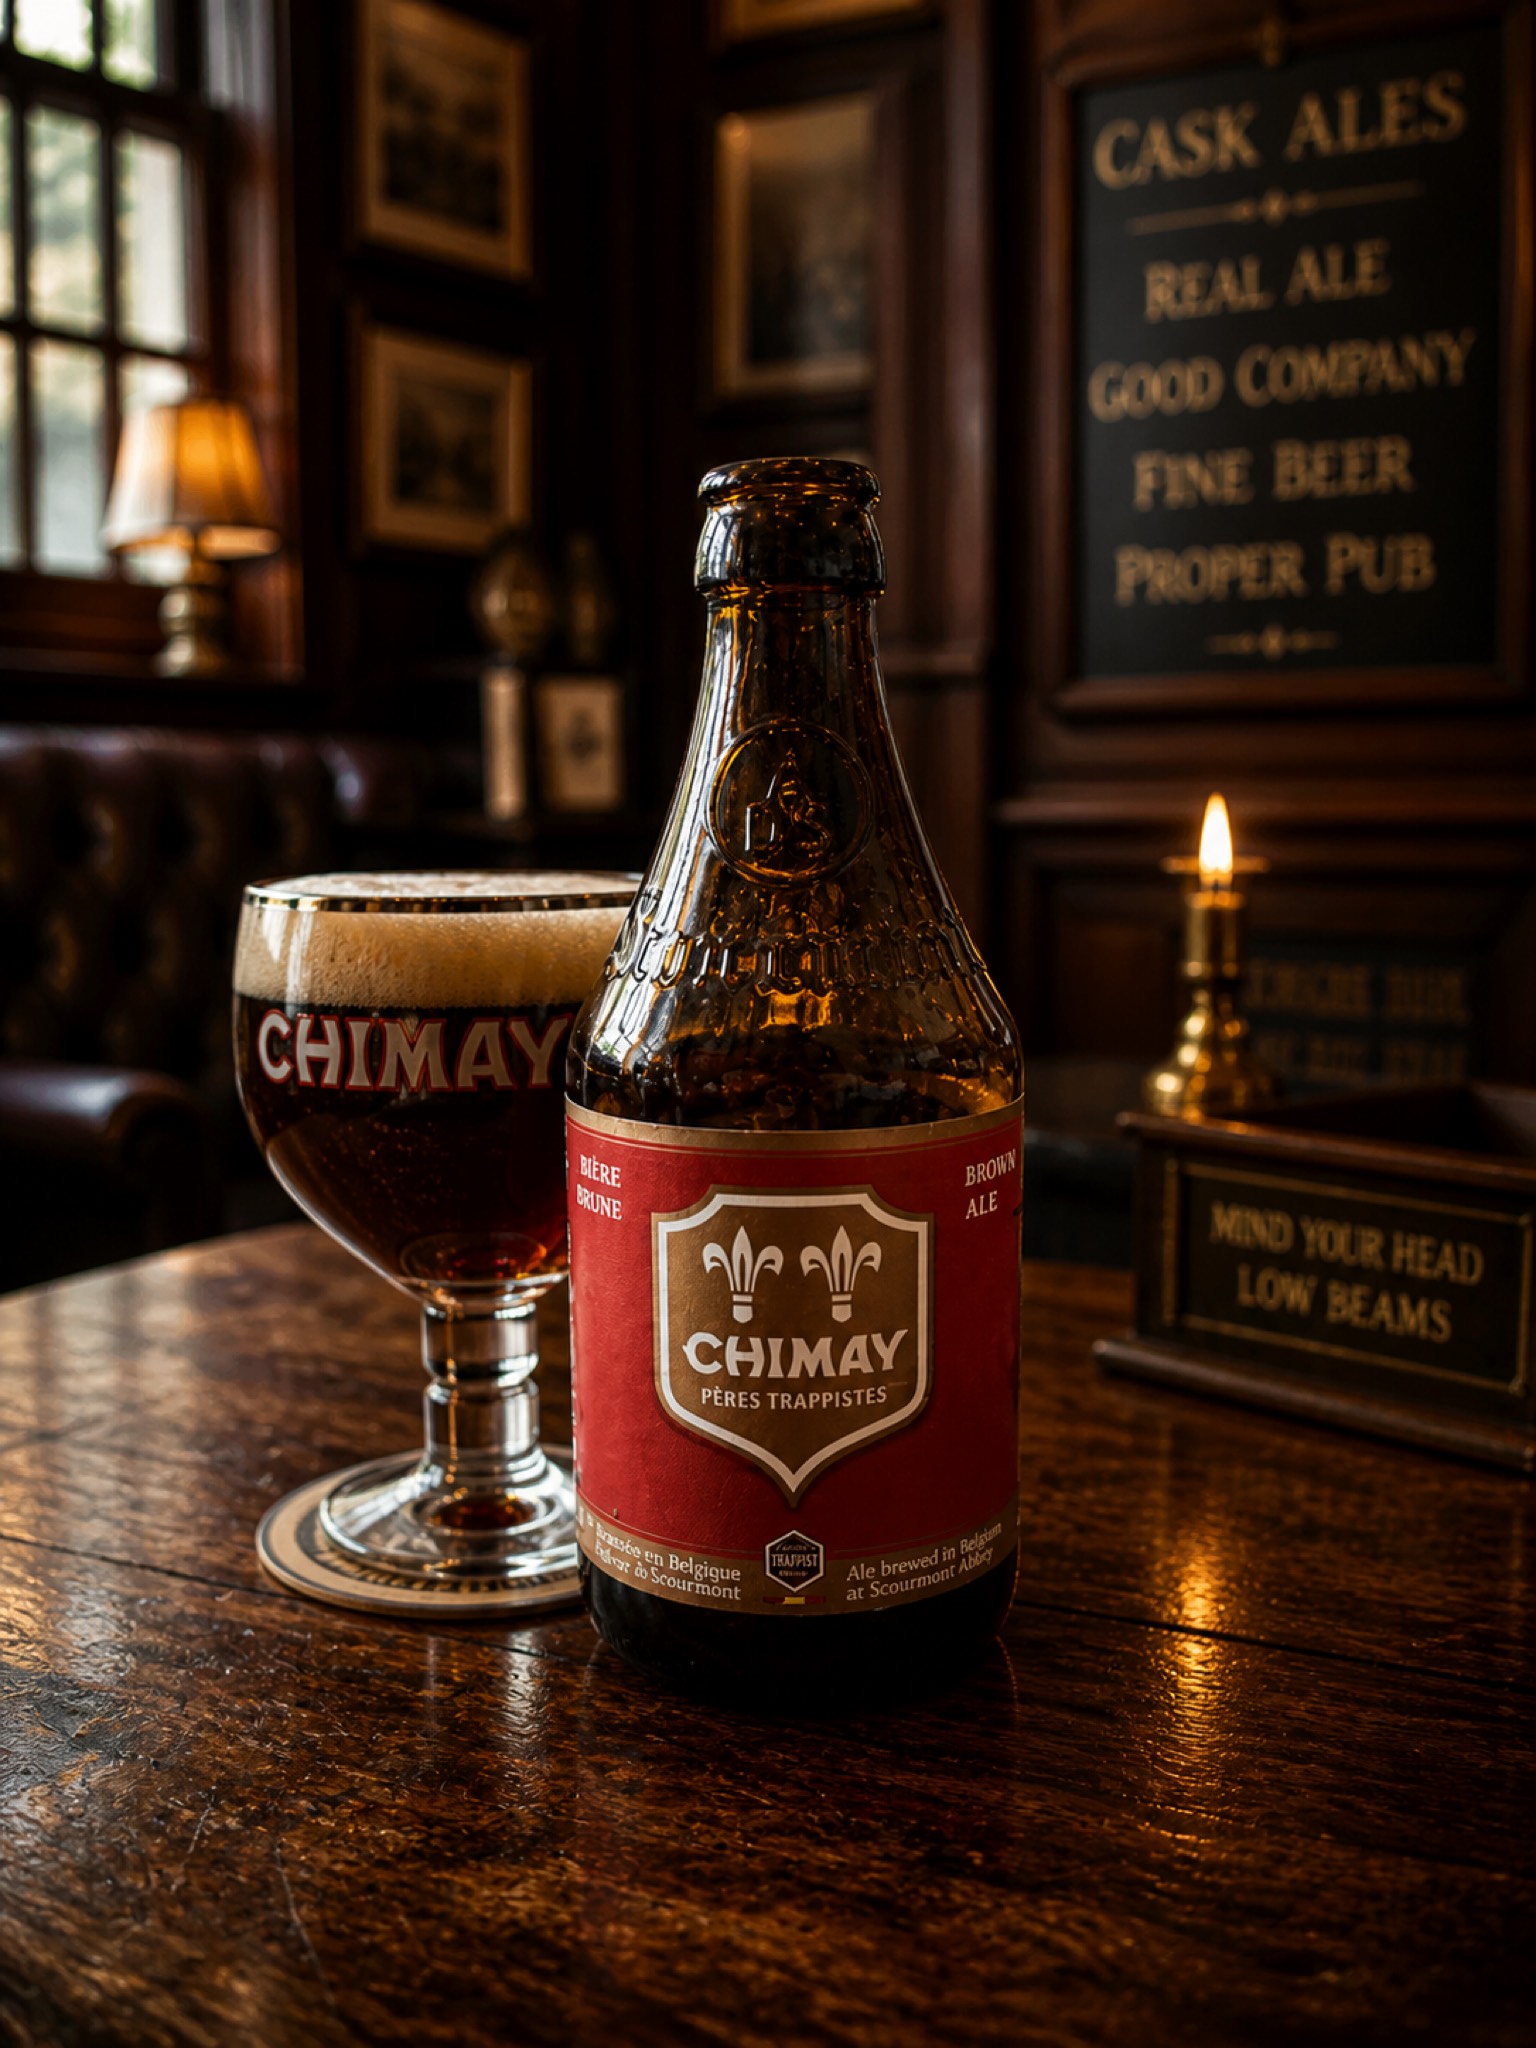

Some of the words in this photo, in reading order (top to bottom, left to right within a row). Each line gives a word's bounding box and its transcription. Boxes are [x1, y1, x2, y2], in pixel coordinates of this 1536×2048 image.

[1093, 103, 1261, 189] CASK
[1284, 71, 1466, 162] ALES
[1145, 255, 1272, 323] REAL
[1285, 238, 1391, 304] ALE
[1089, 355, 1224, 422] GOOD
[1235, 327, 1476, 407] COMPANY
[1133, 447, 1254, 512] FINE
[1273, 434, 1416, 499] BEER
[1115, 541, 1307, 606] PROPER
[1325, 532, 1436, 596] PUB
[258, 1009, 573, 1092] CHIMAY
[580, 1153, 622, 1188] BIÈRE
[964, 1147, 1016, 1187] BROWN
[576, 1183, 622, 1220] BRUNE
[965, 1190, 998, 1220] ALE
[1210, 1201, 1294, 1251] MIND
[1301, 1217, 1385, 1269] YOUR
[1391, 1237, 1484, 1285] HEAD
[1237, 1264, 1316, 1314] LOW
[1326, 1280, 1452, 1343] BEAMS
[682, 1329, 908, 1379] CHIMAY
[702, 1386, 760, 1409] PÈRES
[767, 1386, 887, 1410] TRAPPISTES
[651, 1566, 741, 1600] Scourmont
[669, 1553, 741, 1583] Belgique
[846, 1563, 875, 1581] Ale
[880, 1548, 938, 1577] brewed
[942, 1546, 956, 1562] in
[846, 1586, 864, 1601] at
[870, 1564, 956, 1598] Scourmont
